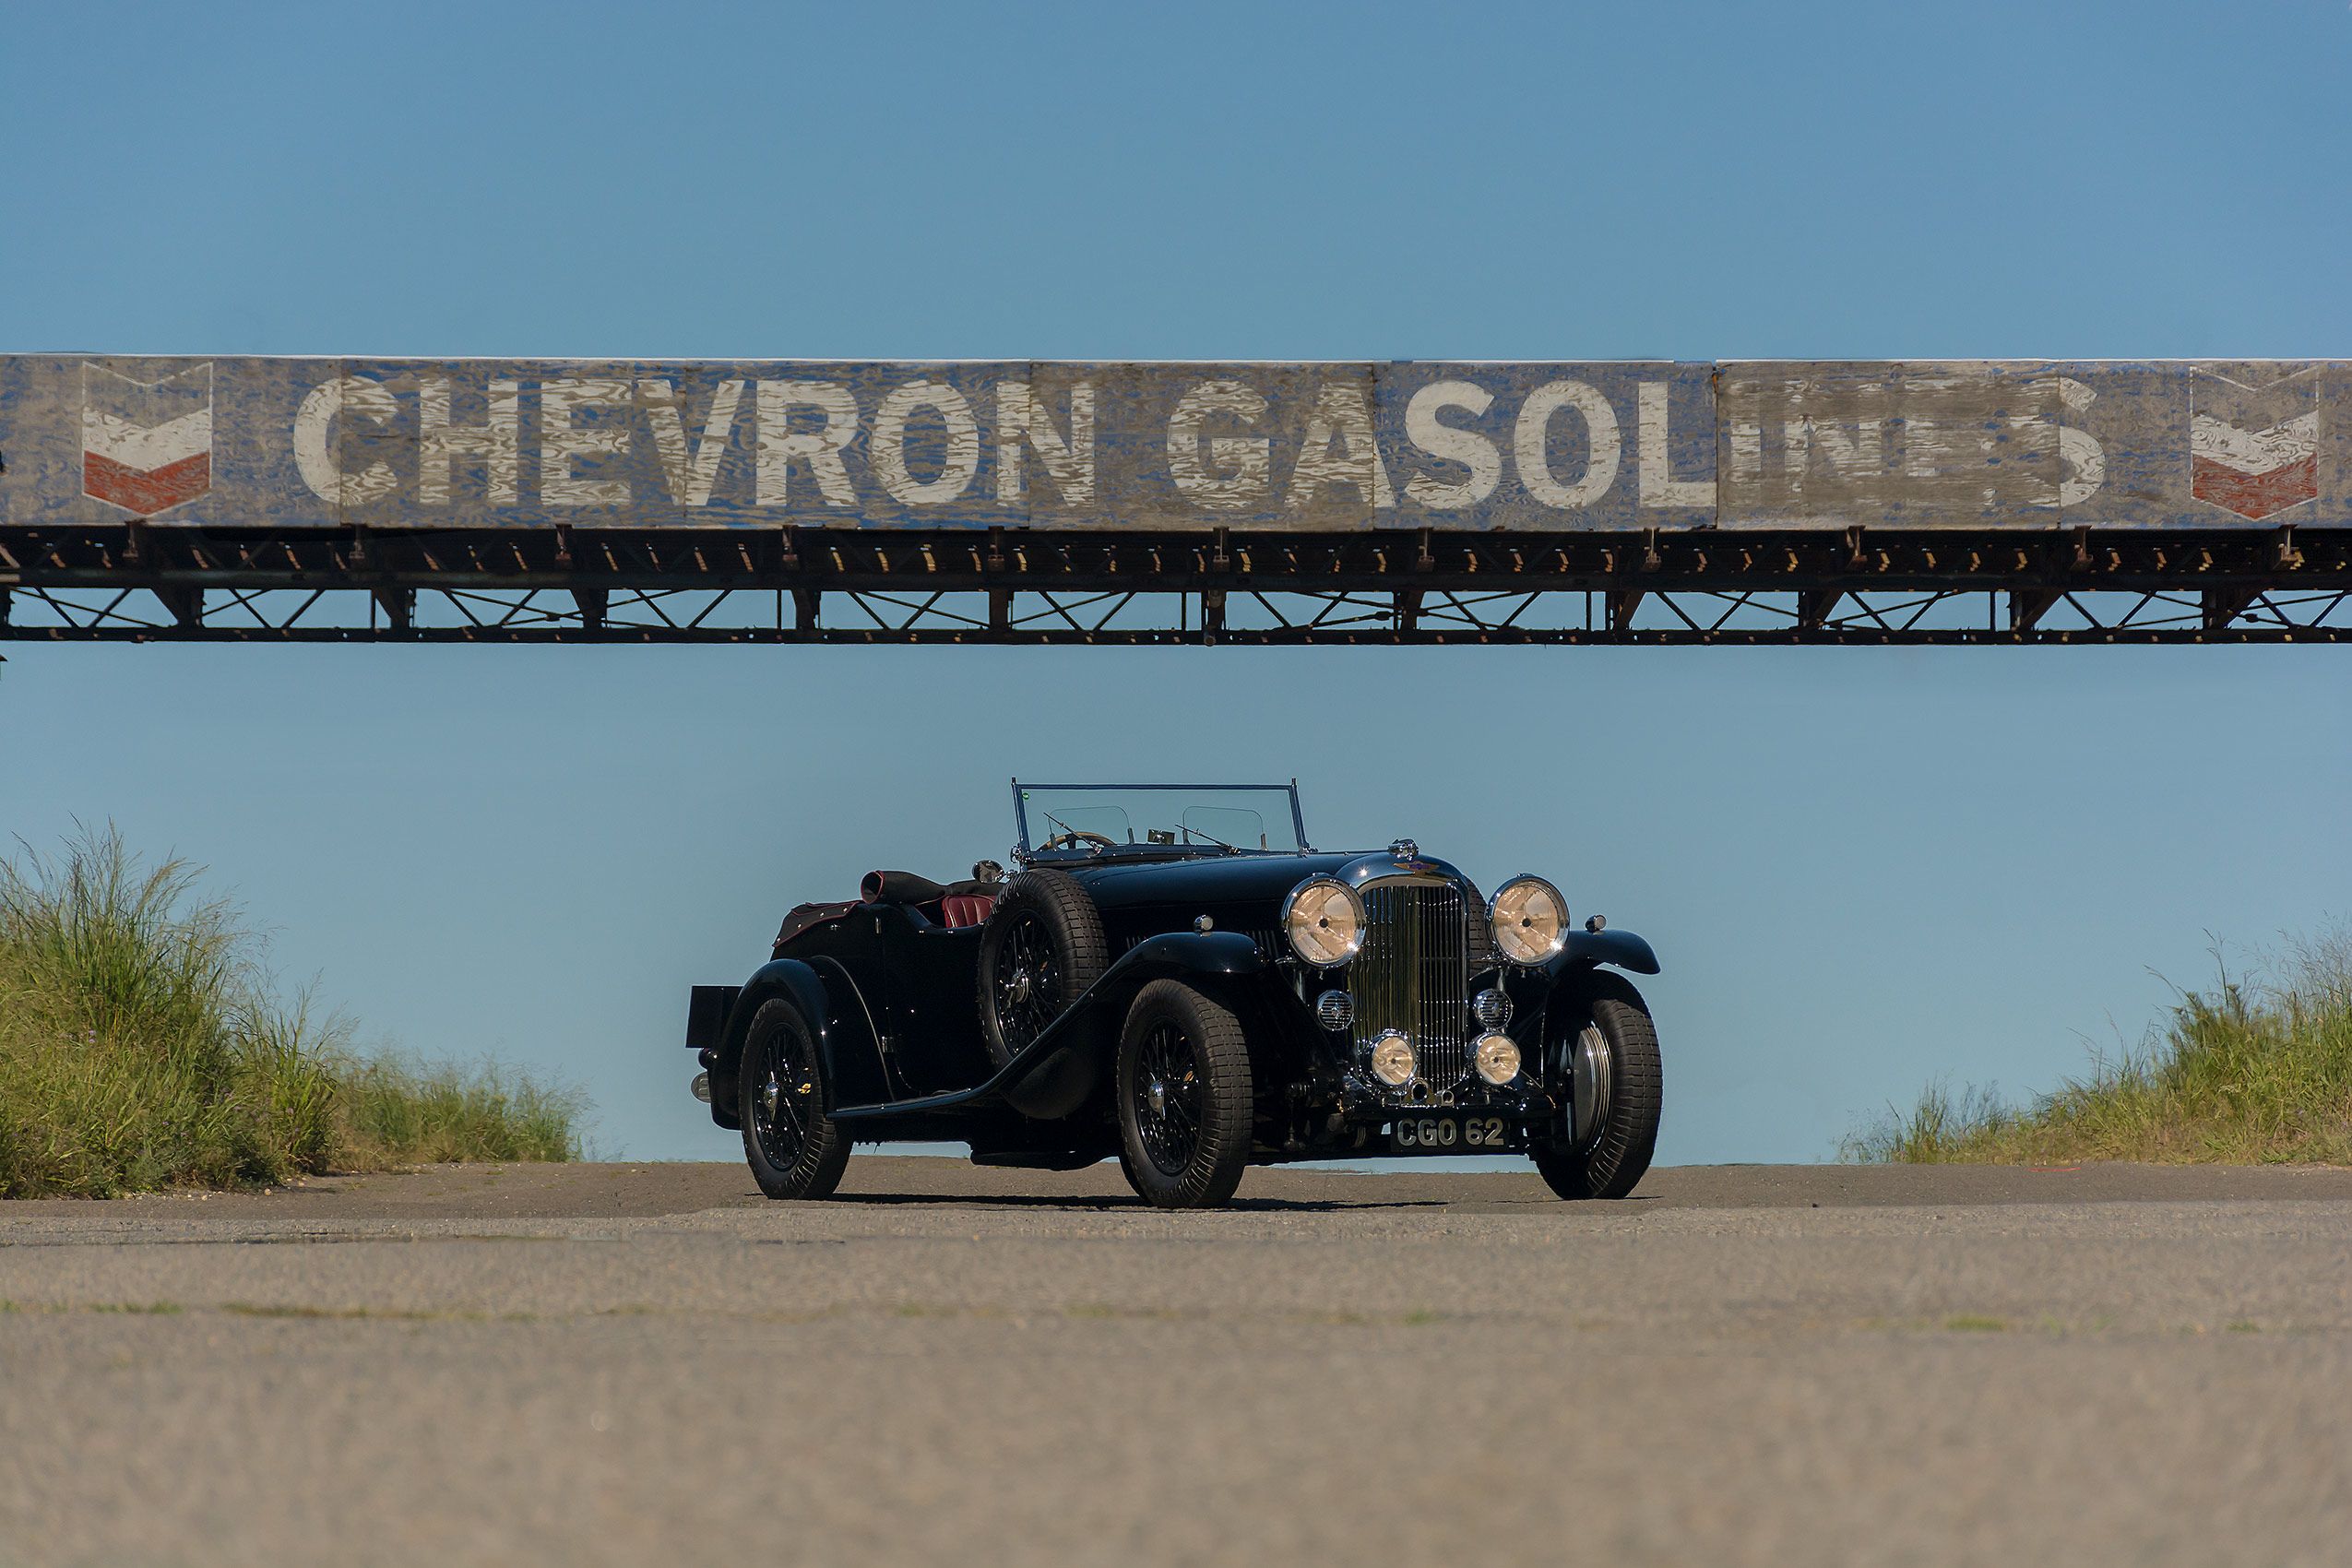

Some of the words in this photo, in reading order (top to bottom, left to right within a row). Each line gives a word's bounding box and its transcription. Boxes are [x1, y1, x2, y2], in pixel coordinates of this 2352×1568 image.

[293, 374, 1096, 507] CHEVRON
[1166, 377, 2107, 510] GASOLINES
[1466, 1117, 1504, 1146] 62
